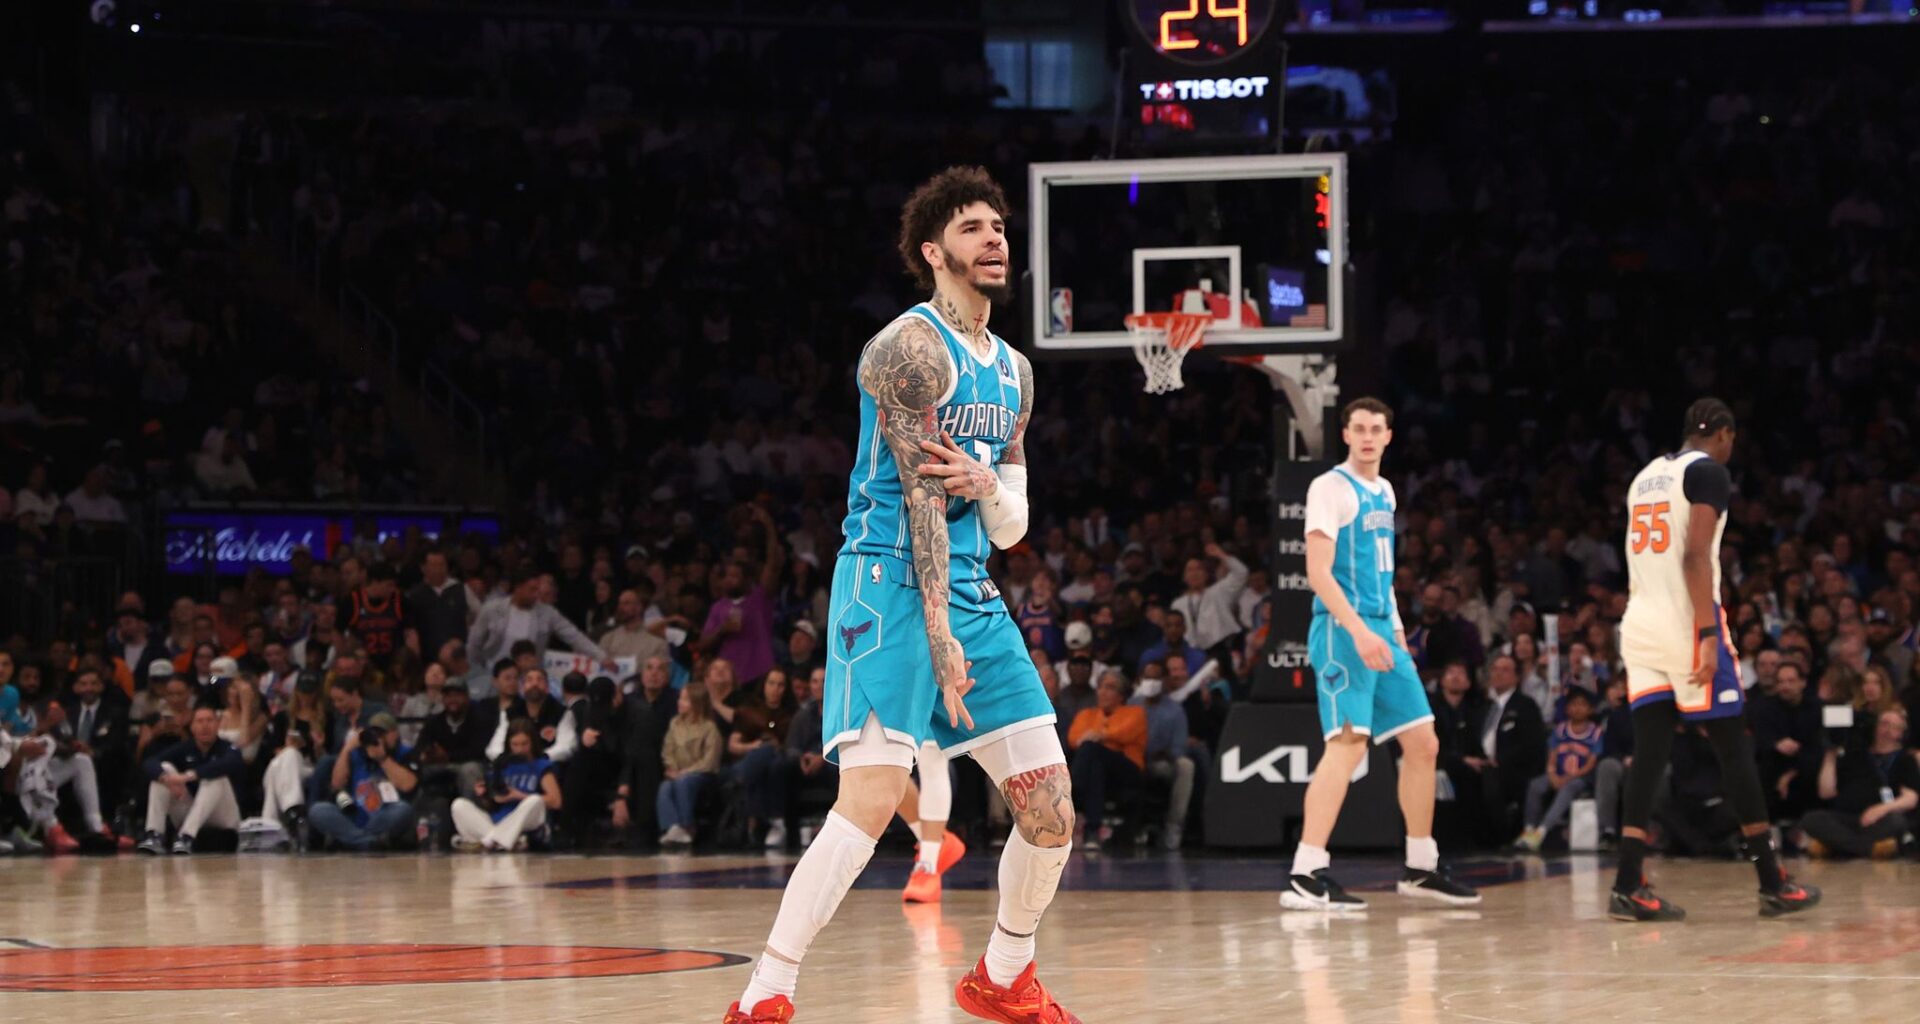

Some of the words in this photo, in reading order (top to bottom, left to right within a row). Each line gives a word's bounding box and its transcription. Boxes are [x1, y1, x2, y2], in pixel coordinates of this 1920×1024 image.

[1160, 0, 1248, 49] 24
[1175, 77, 1269, 100] TISSOT
[940, 402, 1018, 443] HORNET
[1278, 503, 1306, 520] Info
[1631, 501, 1671, 554] 55
[1279, 540, 1306, 555] Info
[1375, 536, 1395, 573] 11
[1278, 574, 1310, 590] Info
